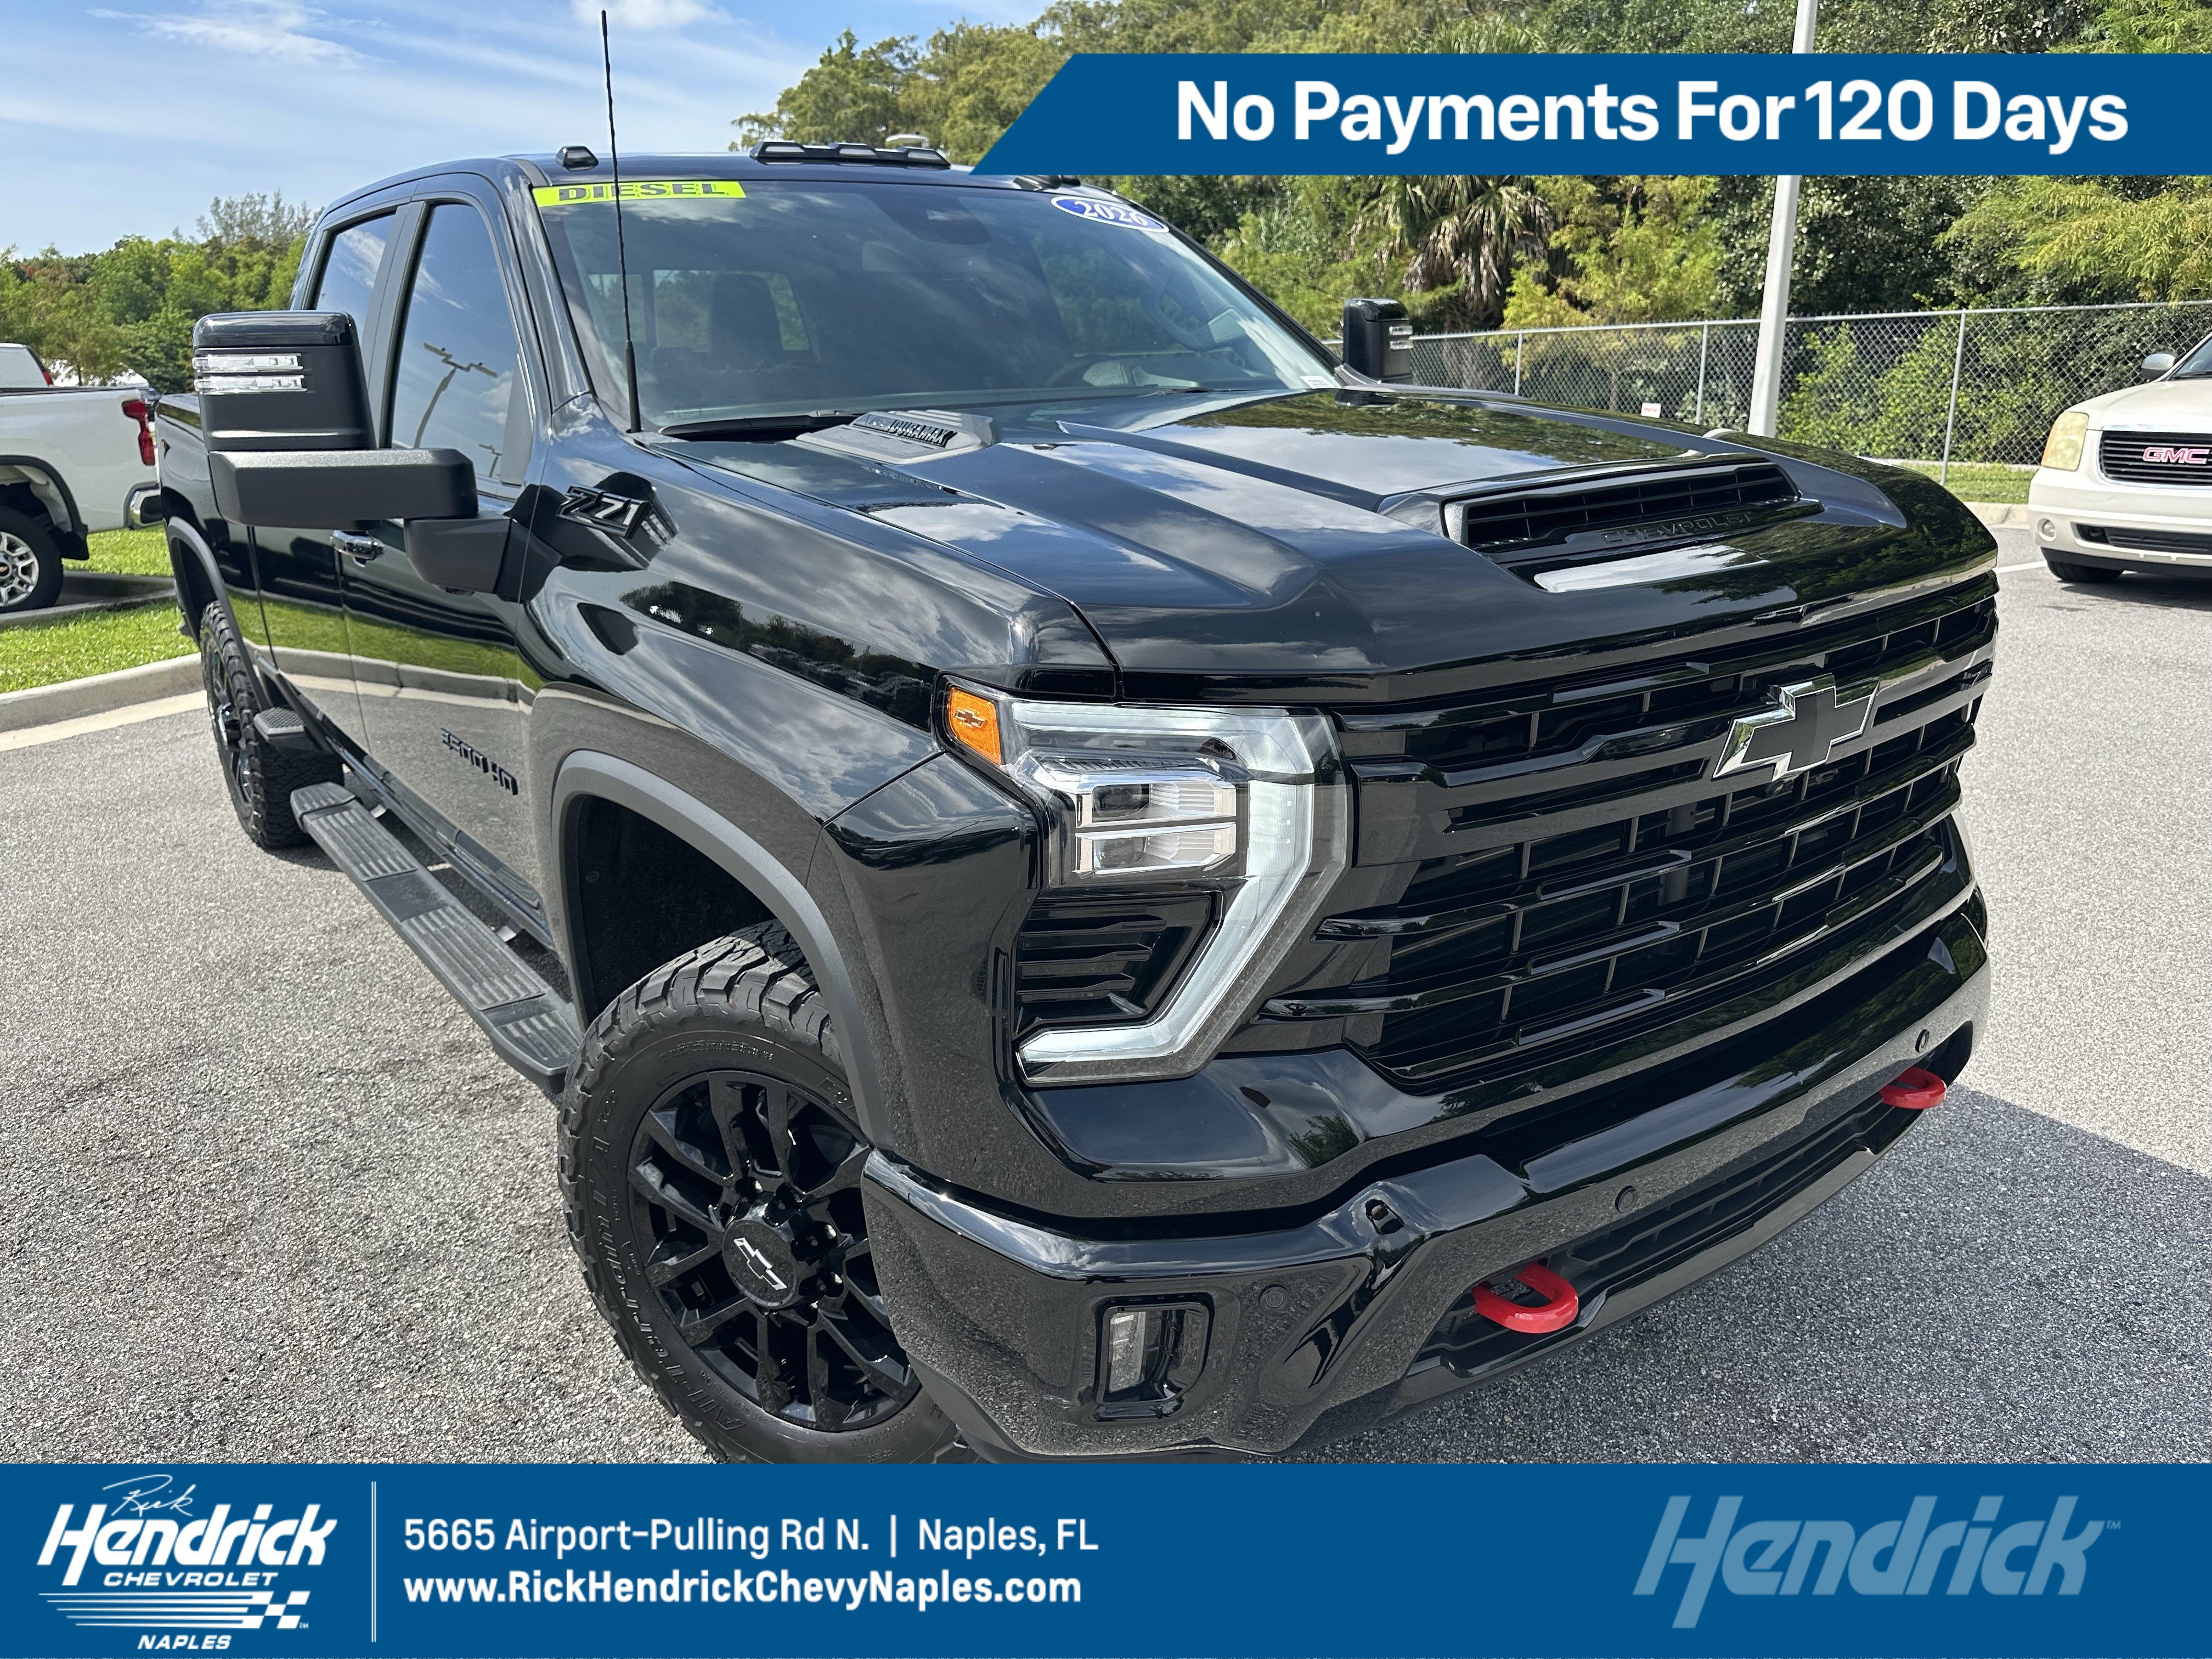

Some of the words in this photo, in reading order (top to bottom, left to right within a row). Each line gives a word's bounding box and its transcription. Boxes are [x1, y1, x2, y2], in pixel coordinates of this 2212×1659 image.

[559, 183, 727, 201] DIESEL
[1074, 201, 1148, 226] 2026
[2142, 447, 2209, 464] GMC
[556, 486, 650, 538] Z71
[1601, 511, 1752, 544] CHEVROLET
